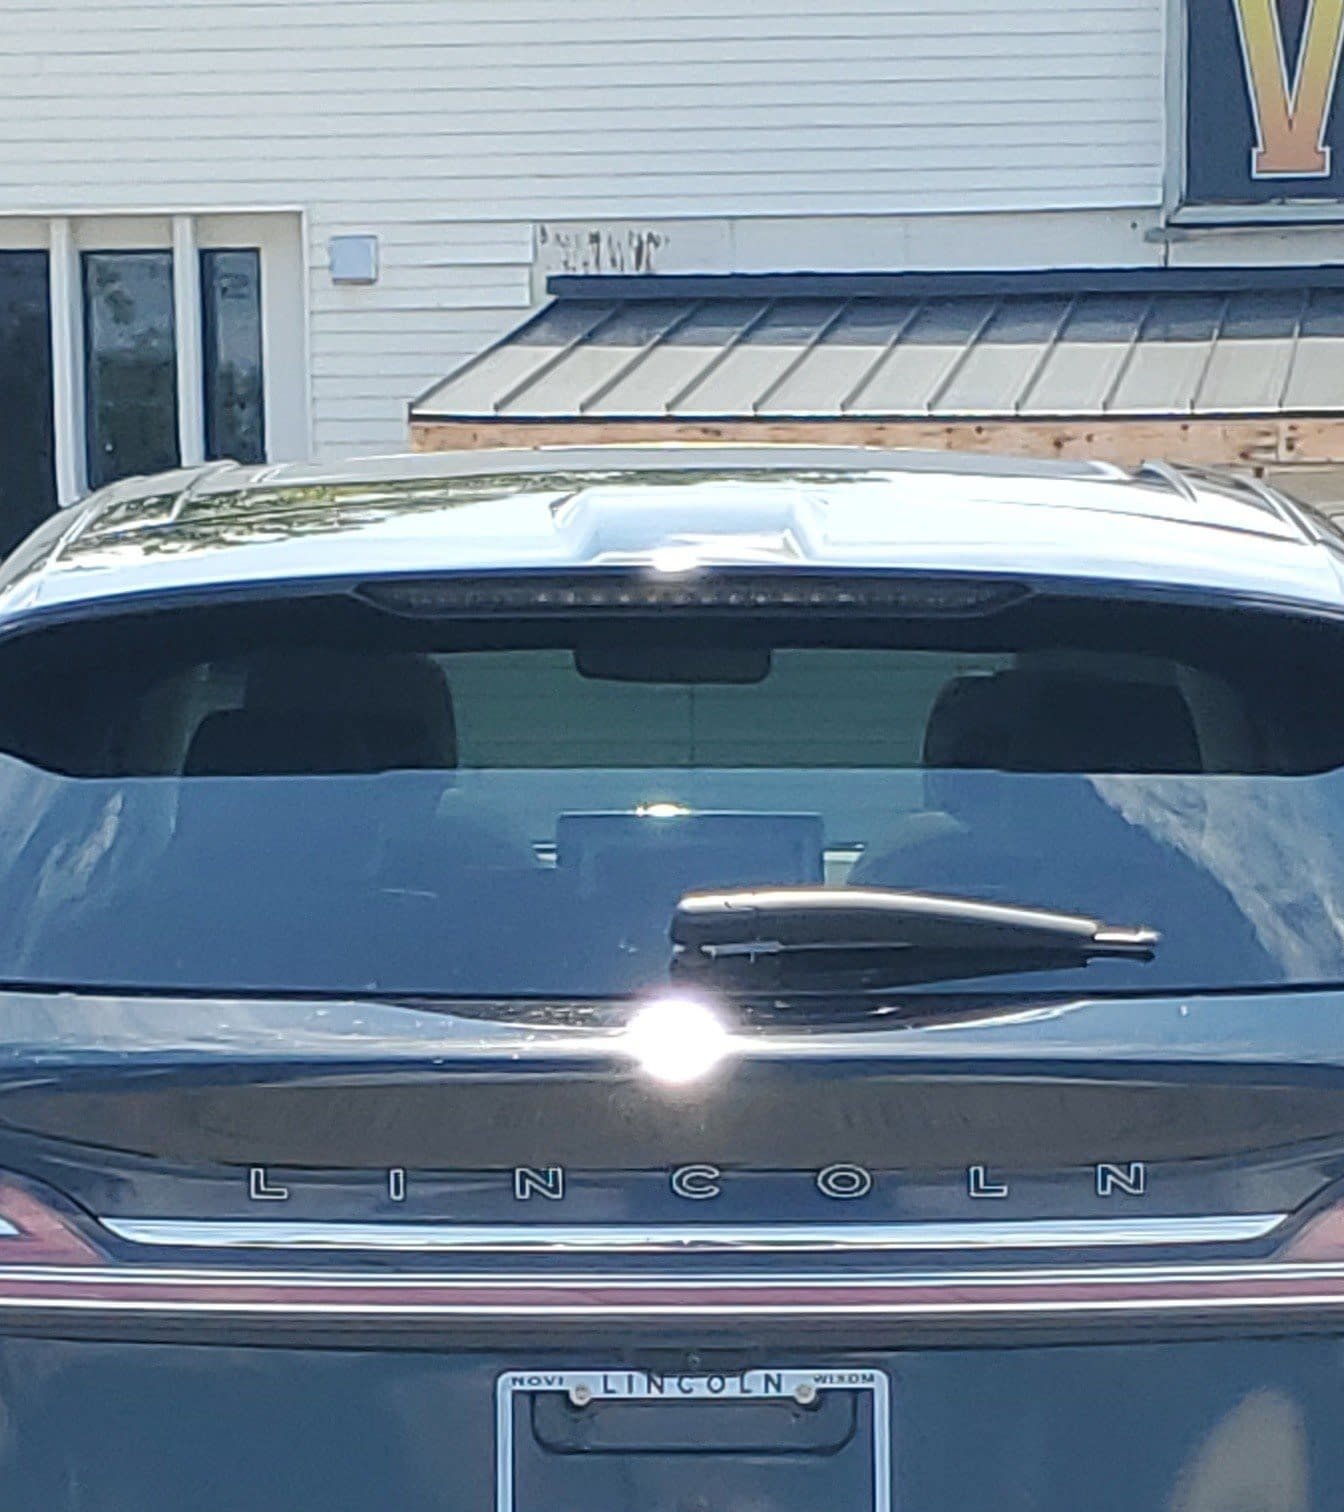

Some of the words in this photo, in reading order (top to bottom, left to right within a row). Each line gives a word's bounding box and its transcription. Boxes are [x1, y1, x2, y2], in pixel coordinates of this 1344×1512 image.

[250, 1162, 1146, 1201] LINCOLN
[511, 1375, 564, 1386] NOVI
[602, 1372, 783, 1395] LINCOLN
